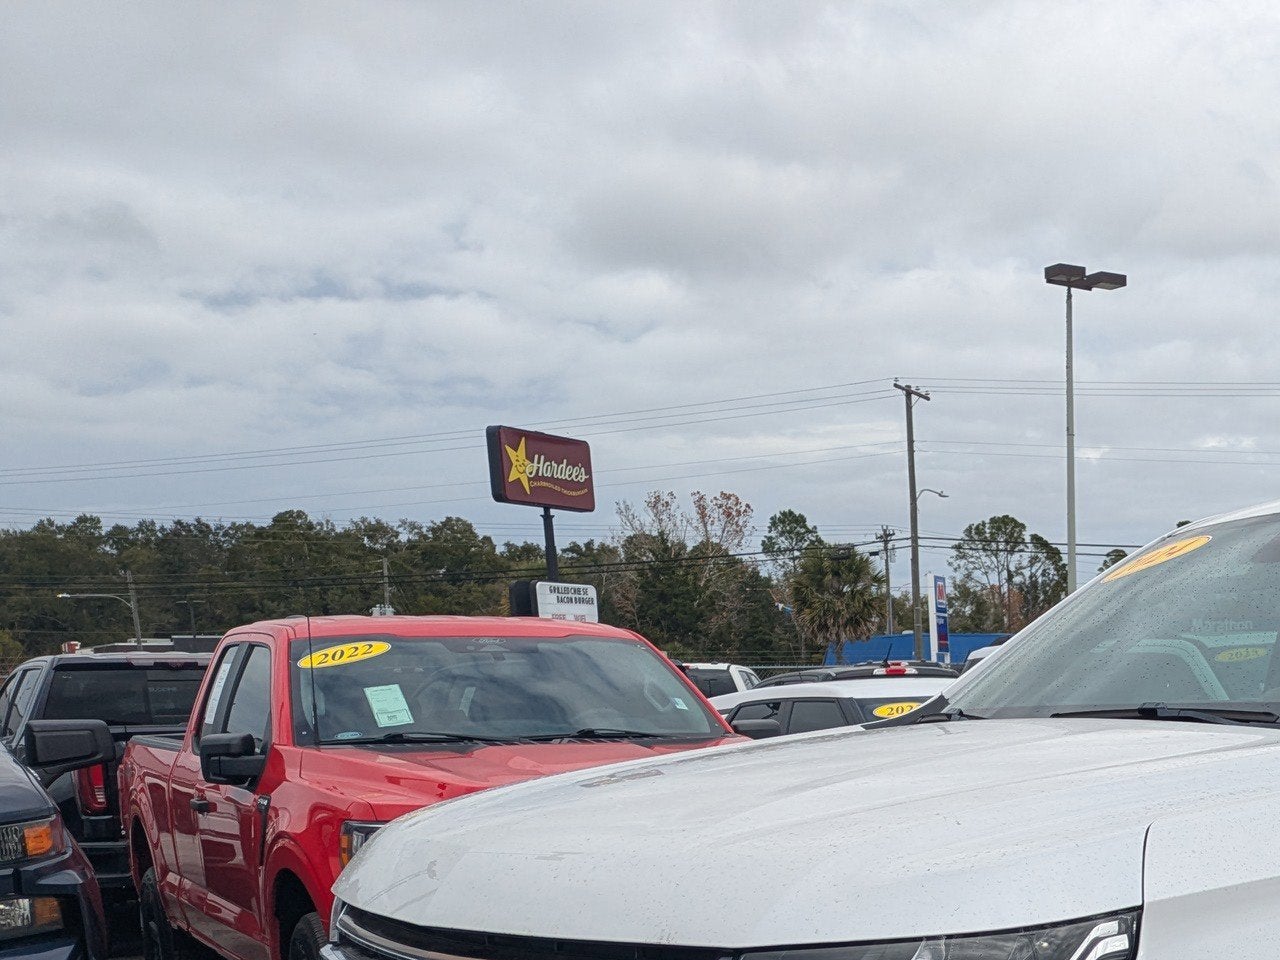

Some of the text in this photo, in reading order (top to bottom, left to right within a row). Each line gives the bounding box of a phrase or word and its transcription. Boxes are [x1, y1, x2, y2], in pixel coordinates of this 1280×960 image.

[526, 454, 589, 483] Hardee's
[556, 595, 595, 605] BACON BURGER
[316, 643, 374, 666] 2022
[886, 704, 916, 716] 202
